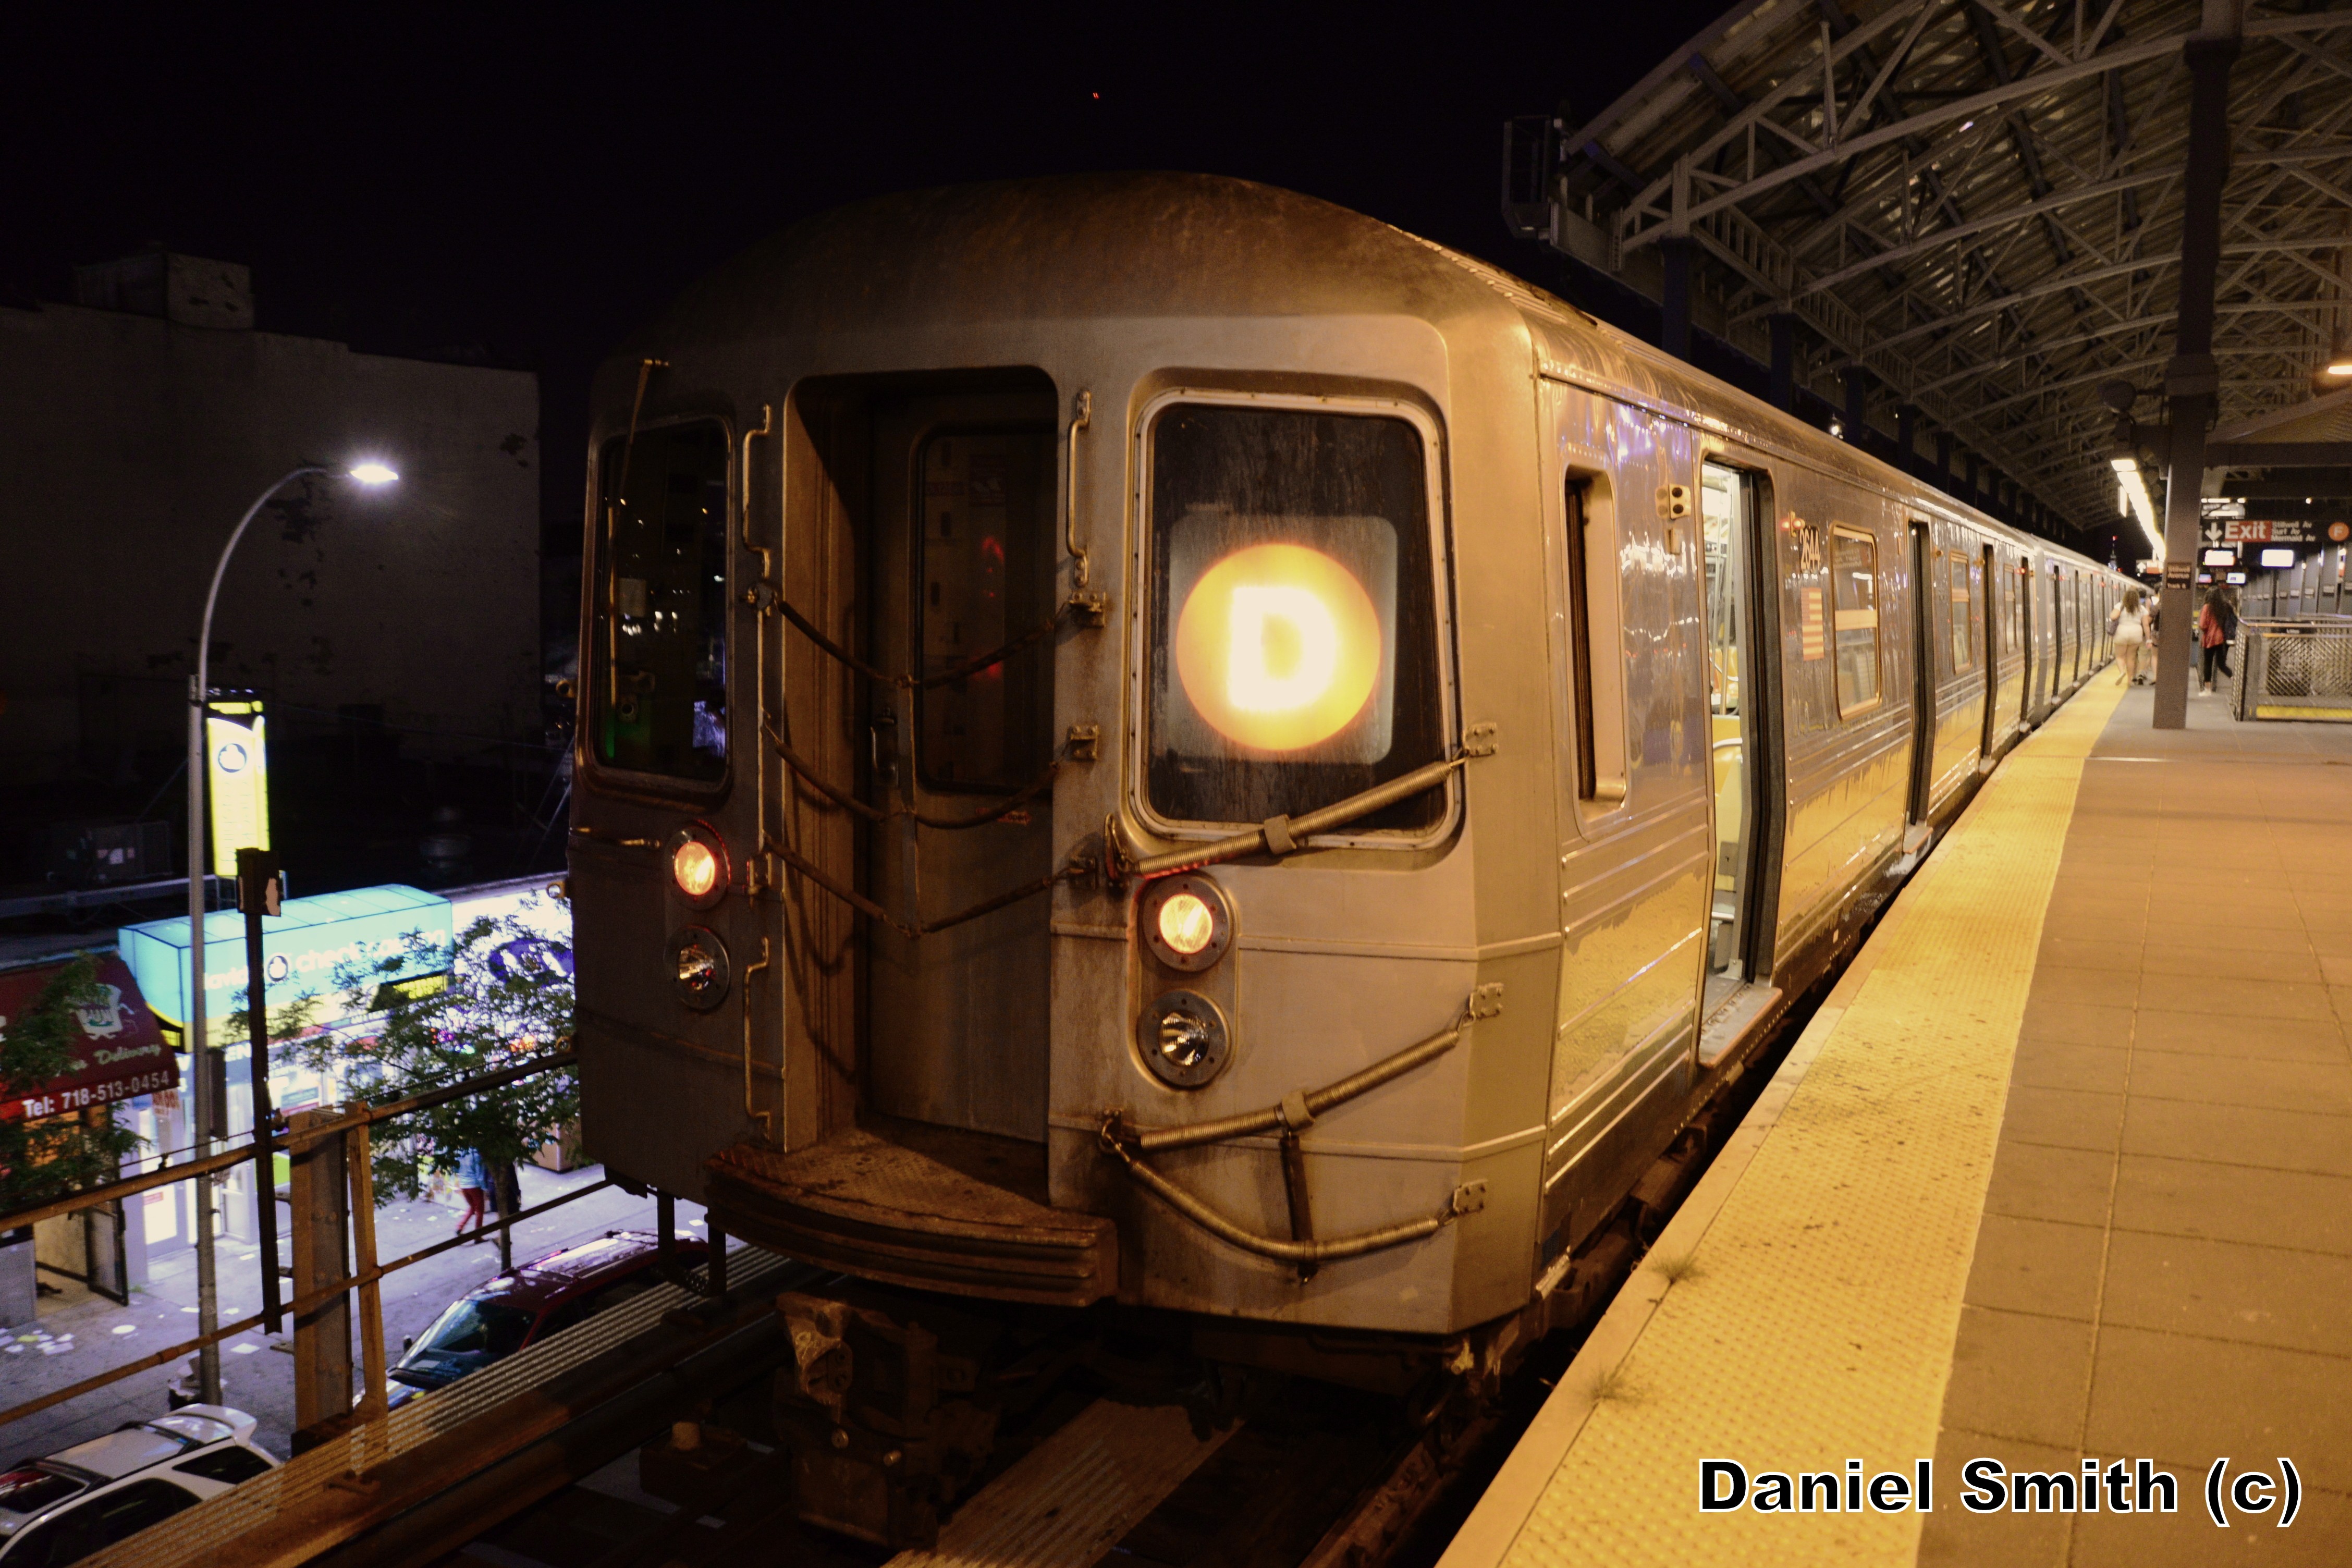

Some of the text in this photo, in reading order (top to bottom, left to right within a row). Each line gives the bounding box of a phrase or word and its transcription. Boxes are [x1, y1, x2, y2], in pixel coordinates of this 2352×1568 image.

[1799, 528, 1820, 571] 2644
[2225, 521, 2267, 539] Exit
[1228, 586, 1336, 712] D
[204, 964, 250, 990] avid
[22, 1096, 55, 1118] Tel:
[61, 1070, 169, 1109] 718-513-0454
